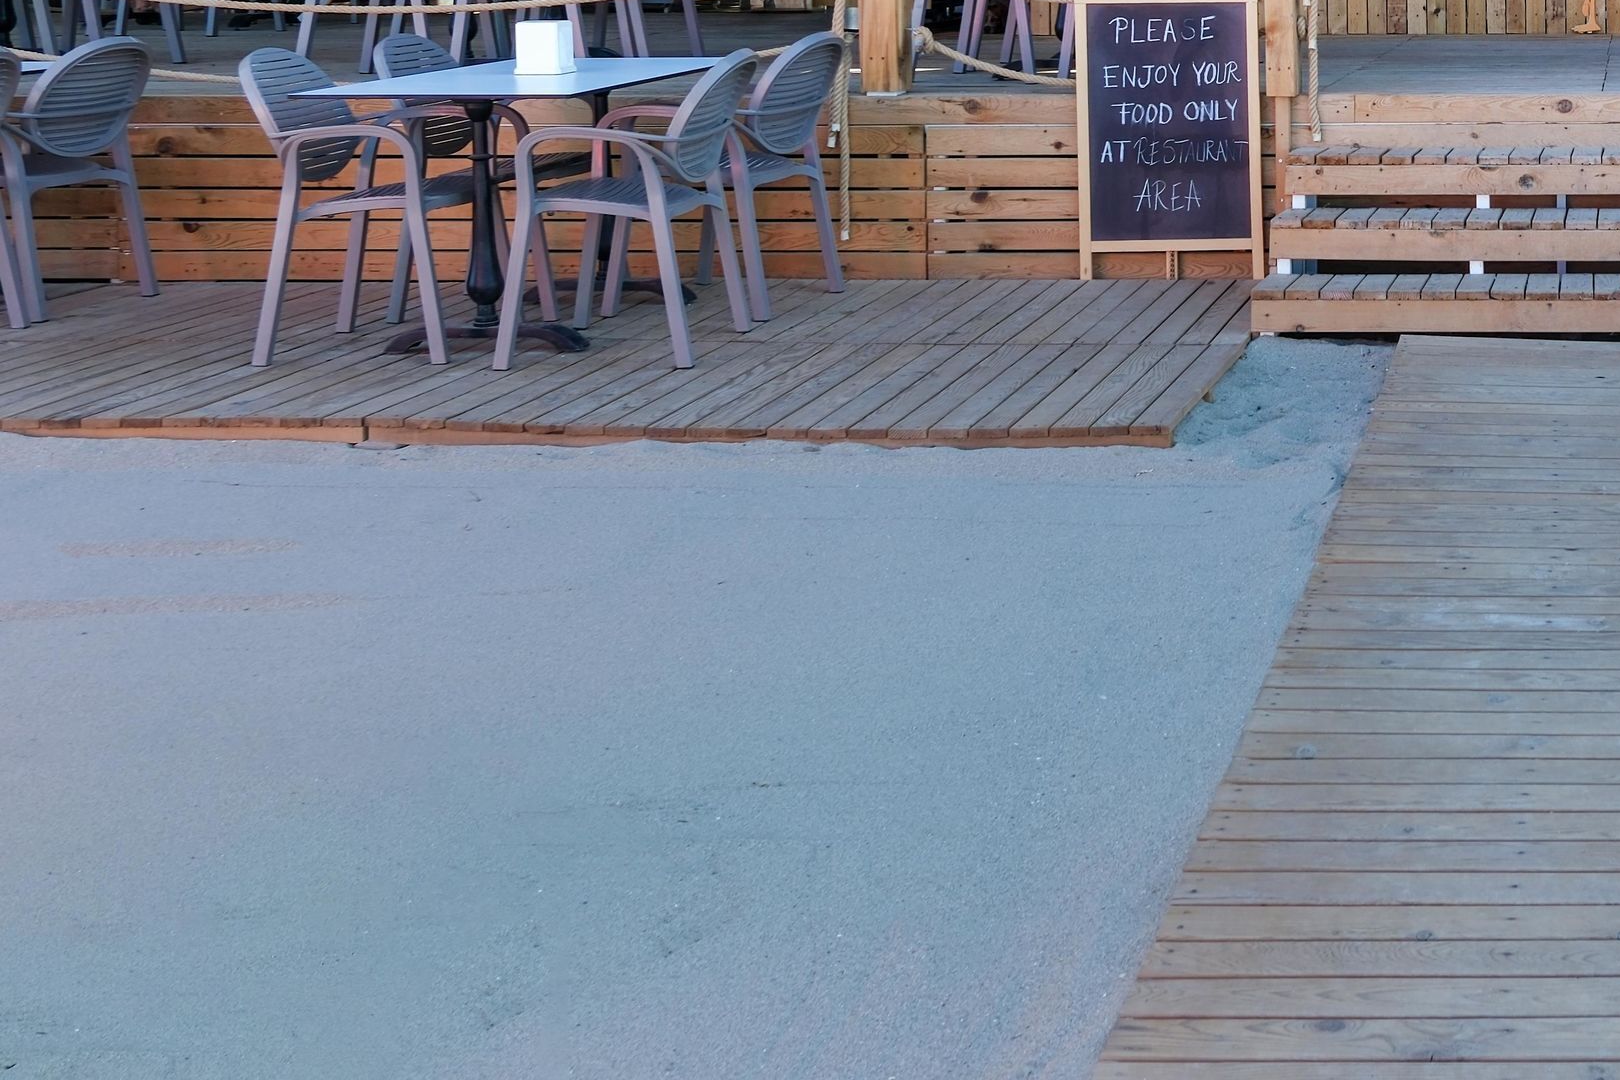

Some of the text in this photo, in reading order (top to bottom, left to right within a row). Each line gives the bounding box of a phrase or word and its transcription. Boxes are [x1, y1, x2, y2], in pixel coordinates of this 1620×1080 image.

[1108, 15, 1216, 44] PLEASE
[1103, 60, 1242, 89] ENJOY YOUR
[1110, 98, 1239, 125] FOOD ONLY
[1100, 136, 1249, 166] AT RESTAURANT
[1132, 178, 1202, 212] AREA
